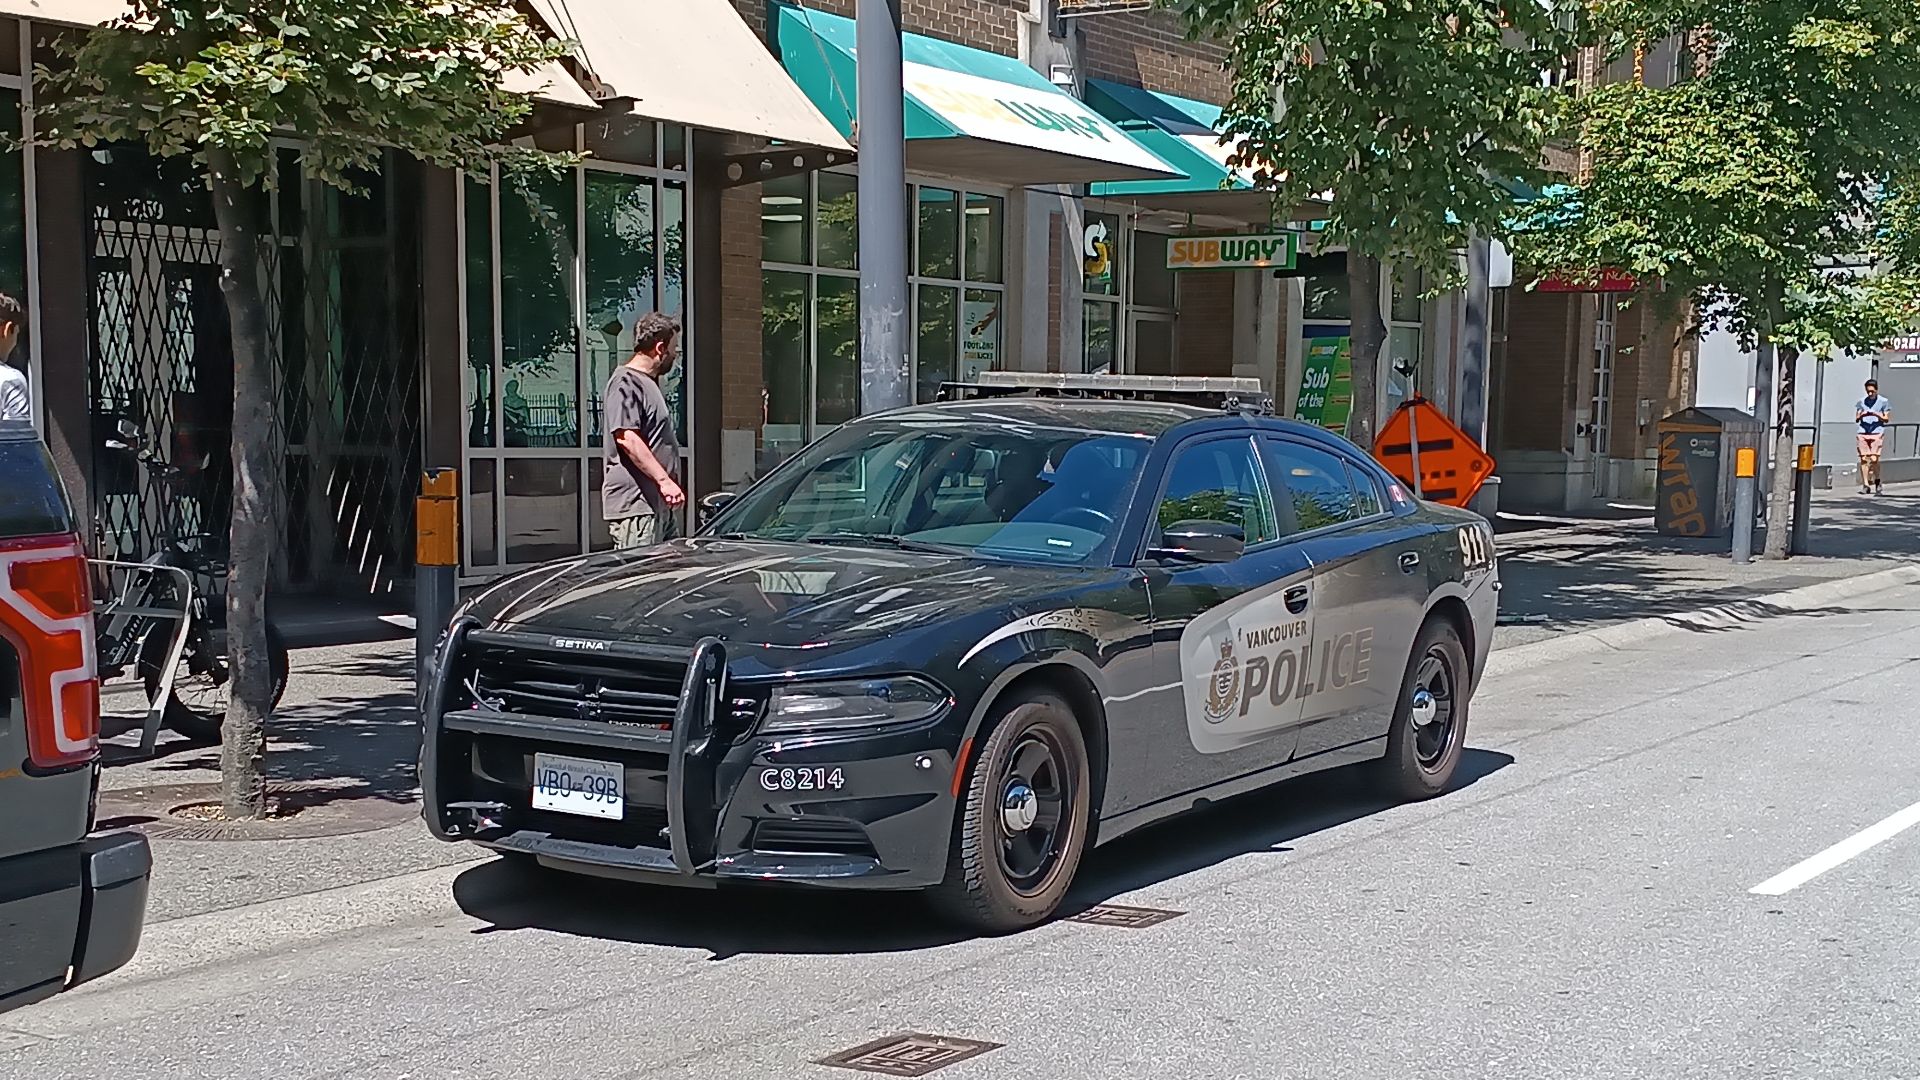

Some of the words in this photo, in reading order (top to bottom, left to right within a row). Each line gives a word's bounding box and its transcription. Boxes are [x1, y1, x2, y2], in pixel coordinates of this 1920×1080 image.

[1169, 239, 1285, 263] SUBWAY
[1302, 366, 1330, 389] Sub
[1298, 393, 1310, 408] of
[1310, 393, 1325, 408] the
[1458, 526, 1486, 567] 911
[555, 639, 604, 651] SETINA
[1246, 620, 1307, 649] VANCOUVER
[1238, 627, 1374, 718] POLICE
[760, 767, 845, 791] C8214
